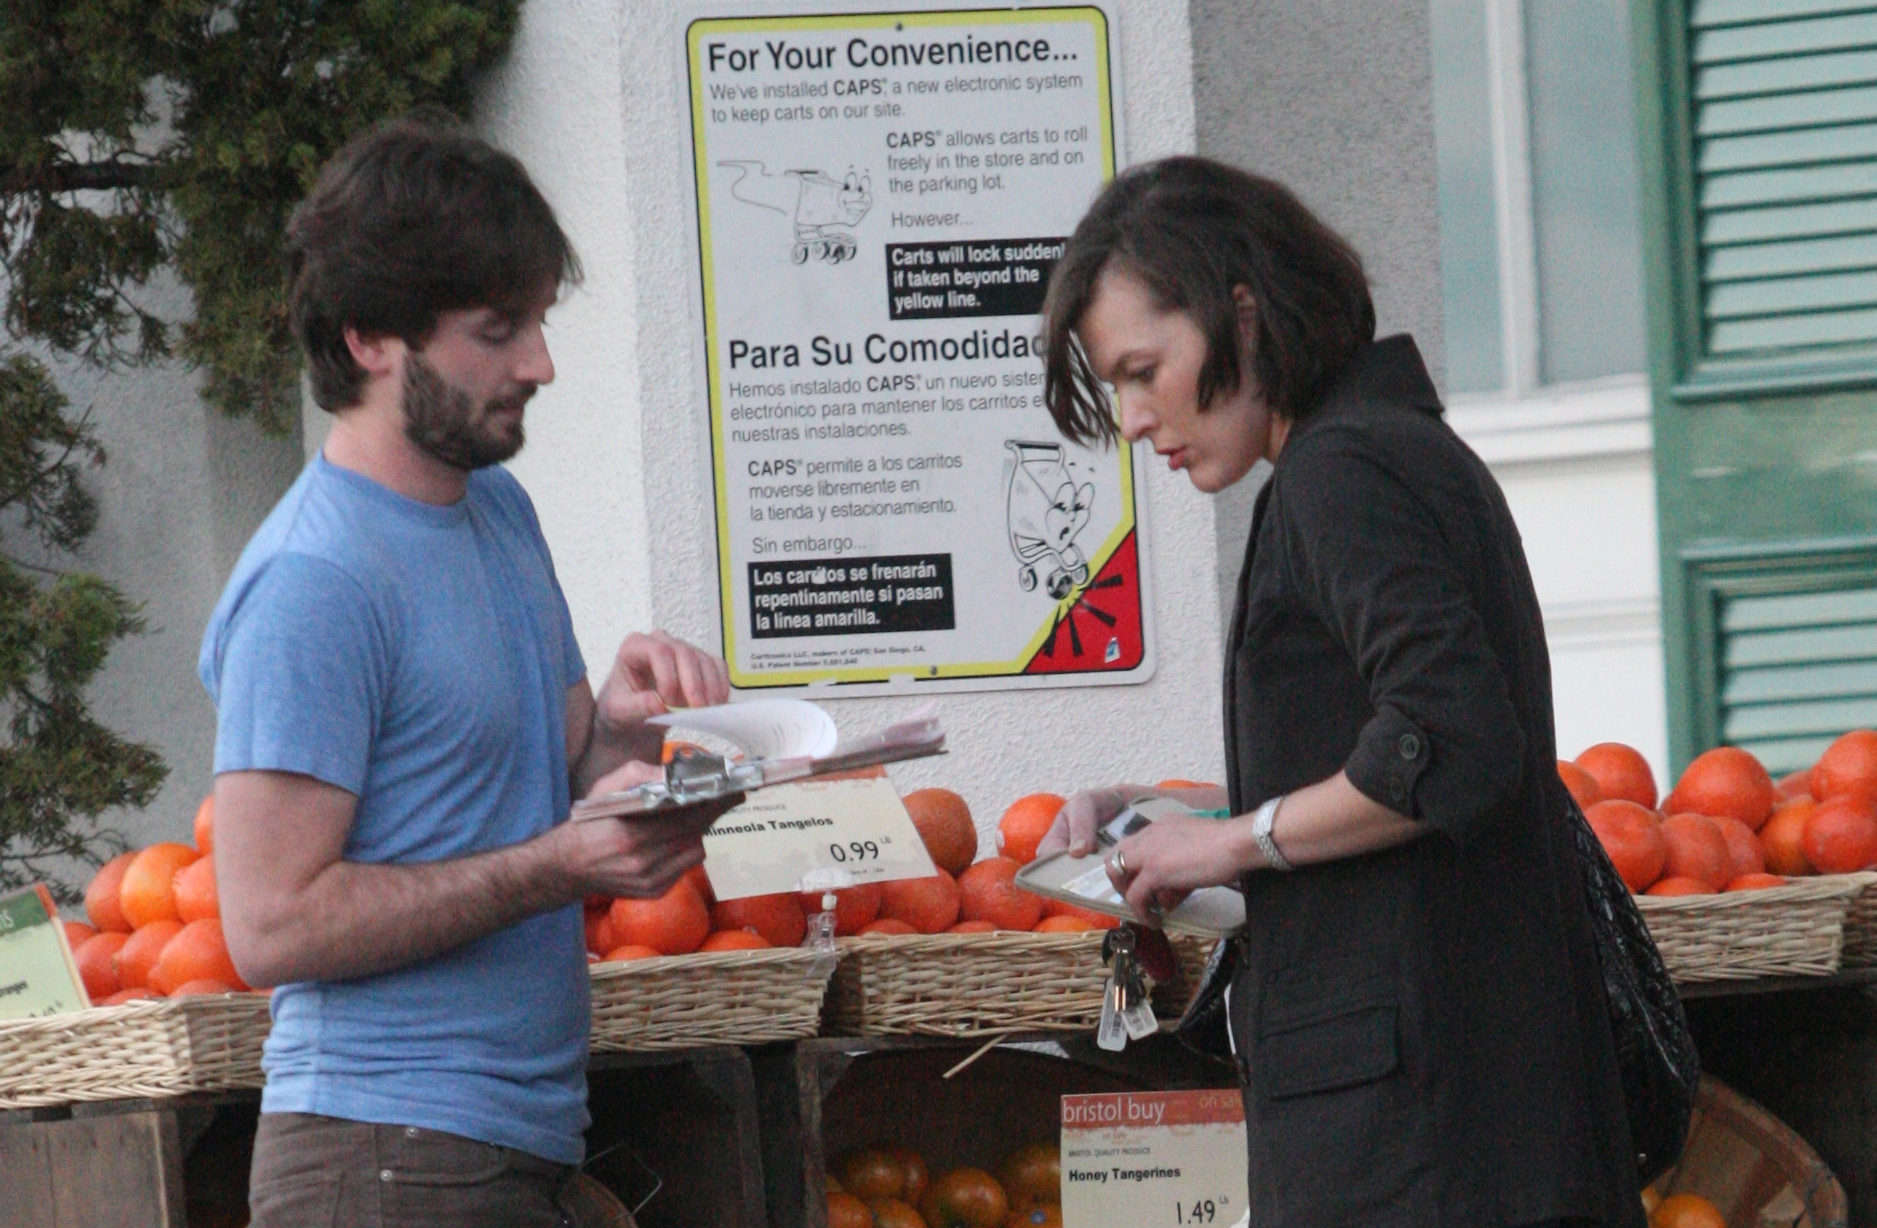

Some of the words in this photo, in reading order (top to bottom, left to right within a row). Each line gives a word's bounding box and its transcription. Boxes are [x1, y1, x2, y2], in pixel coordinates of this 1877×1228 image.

[708, 42, 760, 72] For
[766, 40, 836, 70] Your
[847, 34, 1077, 68] Convenience...
[710, 84, 758, 100] We've
[763, 80, 828, 98] installed
[893, 81, 902, 94] a
[907, 80, 939, 94] new
[944, 75, 1021, 92] electronic
[1026, 74, 1082, 94] system
[711, 108, 726, 122] to
[731, 106, 769, 124] keep
[774, 106, 814, 120] carts
[819, 107, 838, 119] on
[843, 105, 869, 118] our
[946, 130, 995, 147] allows
[1000, 129, 1039, 145] carts
[1044, 128, 1060, 143] to
[1064, 126, 1088, 143] roll
[887, 154, 931, 173] freely
[936, 154, 950, 168] in
[955, 152, 980, 168] the
[985, 152, 1024, 167] store
[1029, 149, 1060, 166] and
[1064, 151, 1084, 165] on
[889, 177, 914, 193] the
[918, 175, 977, 196] parking
[982, 174, 1005, 190] lot.
[891, 247, 934, 266] Carts
[937, 245, 965, 264] will
[967, 244, 1001, 263] lock
[1004, 242, 1066, 261] sudden
[893, 270, 905, 288] if
[907, 269, 950, 288] taken
[953, 266, 1011, 289] beyond
[1014, 264, 1040, 283] the
[894, 292, 944, 314] yellow
[947, 290, 981, 308] line.
[729, 339, 800, 369] Para
[811, 335, 853, 367] Su
[729, 382, 785, 398] Hemos
[790, 378, 861, 396] instalado
[925, 376, 944, 390] un
[951, 374, 997, 389] nuevo
[730, 402, 817, 421] electrónico
[822, 401, 856, 420] para
[862, 398, 936, 415] mantener
[942, 395, 964, 411] los
[968, 394, 1027, 410] carritos
[732, 425, 799, 442] nuestras
[806, 457, 863, 477] permite
[867, 459, 877, 472] a
[881, 456, 903, 472] los
[907, 453, 963, 470] carritos
[750, 484, 813, 499] moverse
[817, 478, 896, 496] libremente
[900, 479, 920, 493] en
[751, 506, 764, 521] la
[768, 504, 813, 520] tienda
[818, 506, 827, 522] y
[753, 536, 777, 554] Sin
[754, 568, 782, 586] Los
[850, 566, 868, 581] se
[871, 560, 937, 581] frenarán
[755, 587, 875, 611] repentinamente
[878, 584, 892, 602] si
[896, 586, 943, 605] pasan
[756, 612, 770, 631] la
[815, 608, 881, 627] amarilla.
[768, 816, 834, 831] Tangelos
[830, 840, 879, 862] 0.99
[1063, 1096, 1122, 1124] bristol
[1128, 1096, 1166, 1125] buy
[1069, 1168, 1108, 1183] Honey
[1112, 1166, 1181, 1182] Tangerines
[1176, 1200, 1215, 1225] 1.49
